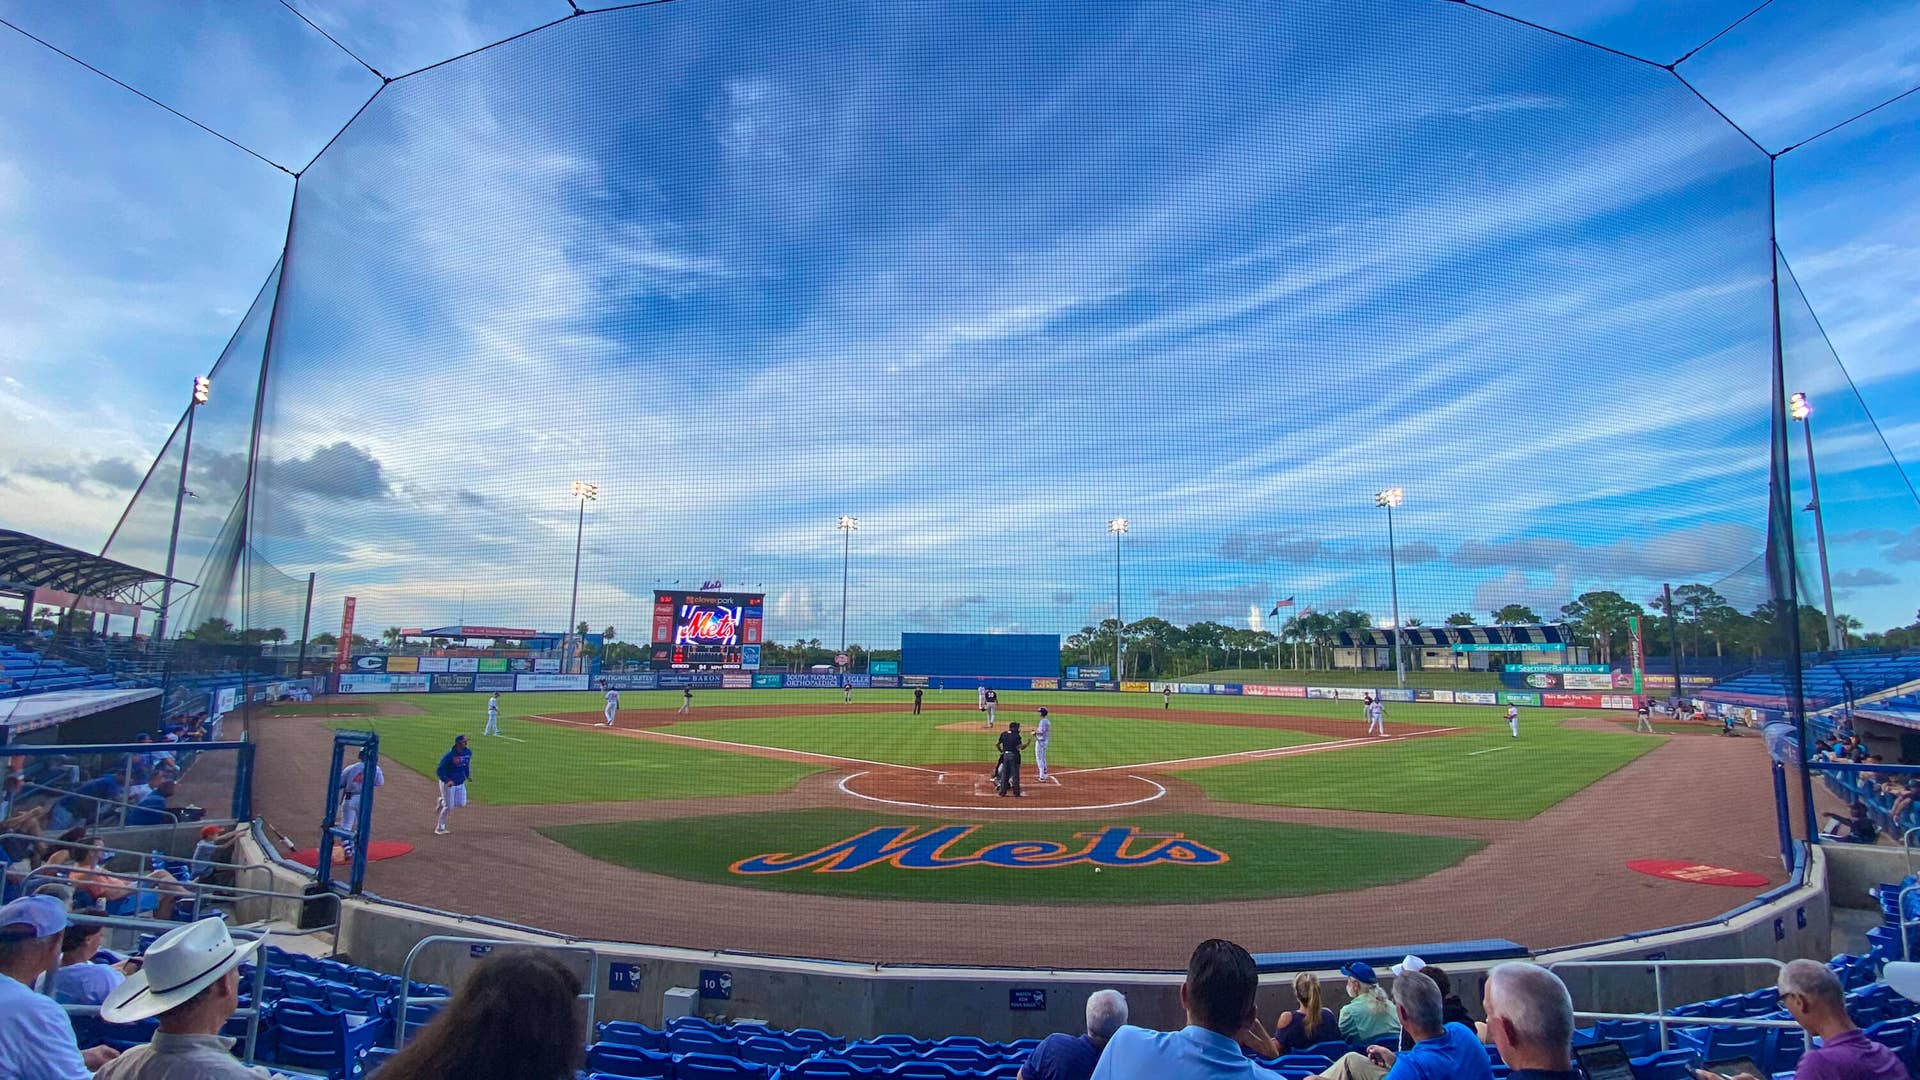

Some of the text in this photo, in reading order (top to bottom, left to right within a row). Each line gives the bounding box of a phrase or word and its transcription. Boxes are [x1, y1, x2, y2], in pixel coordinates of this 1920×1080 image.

[701, 580, 722, 590] Mets
[680, 610, 736, 639] Mets
[729, 824, 1230, 876] Mets
[615, 972, 623, 981] 11
[704, 979, 716, 989] 10
